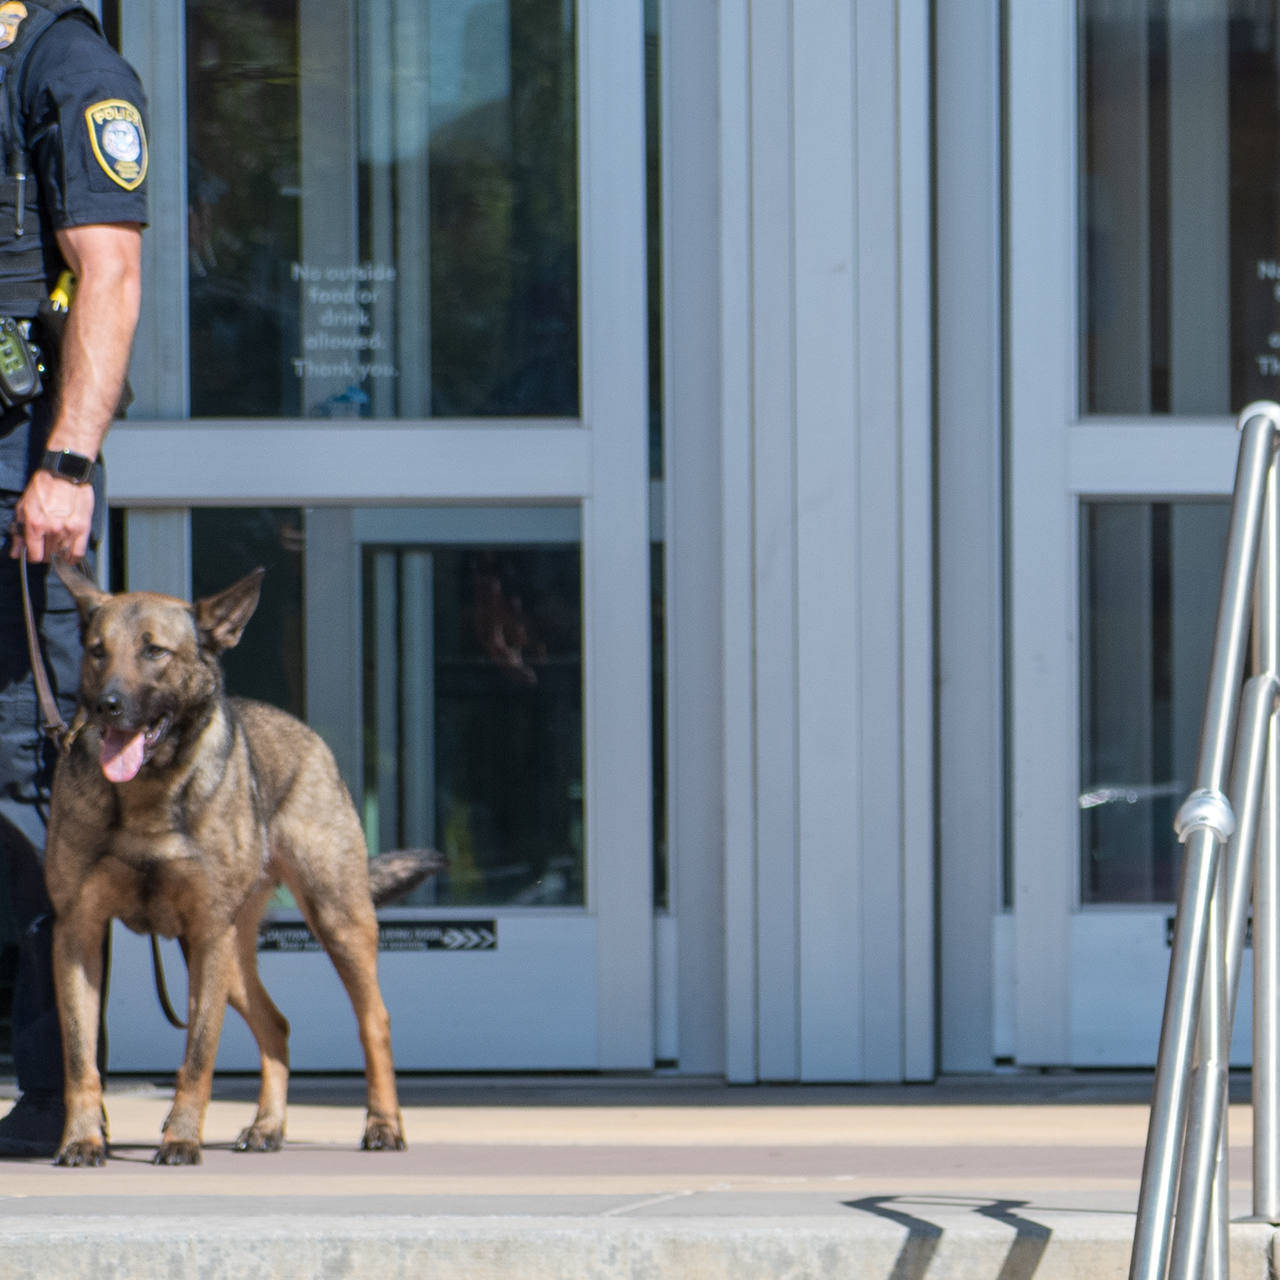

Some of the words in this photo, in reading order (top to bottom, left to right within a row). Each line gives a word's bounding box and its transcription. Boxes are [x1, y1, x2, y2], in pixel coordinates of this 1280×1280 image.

[326, 263, 395, 281] outside
[309, 286, 355, 304] food
[292, 357, 354, 378] Thank
